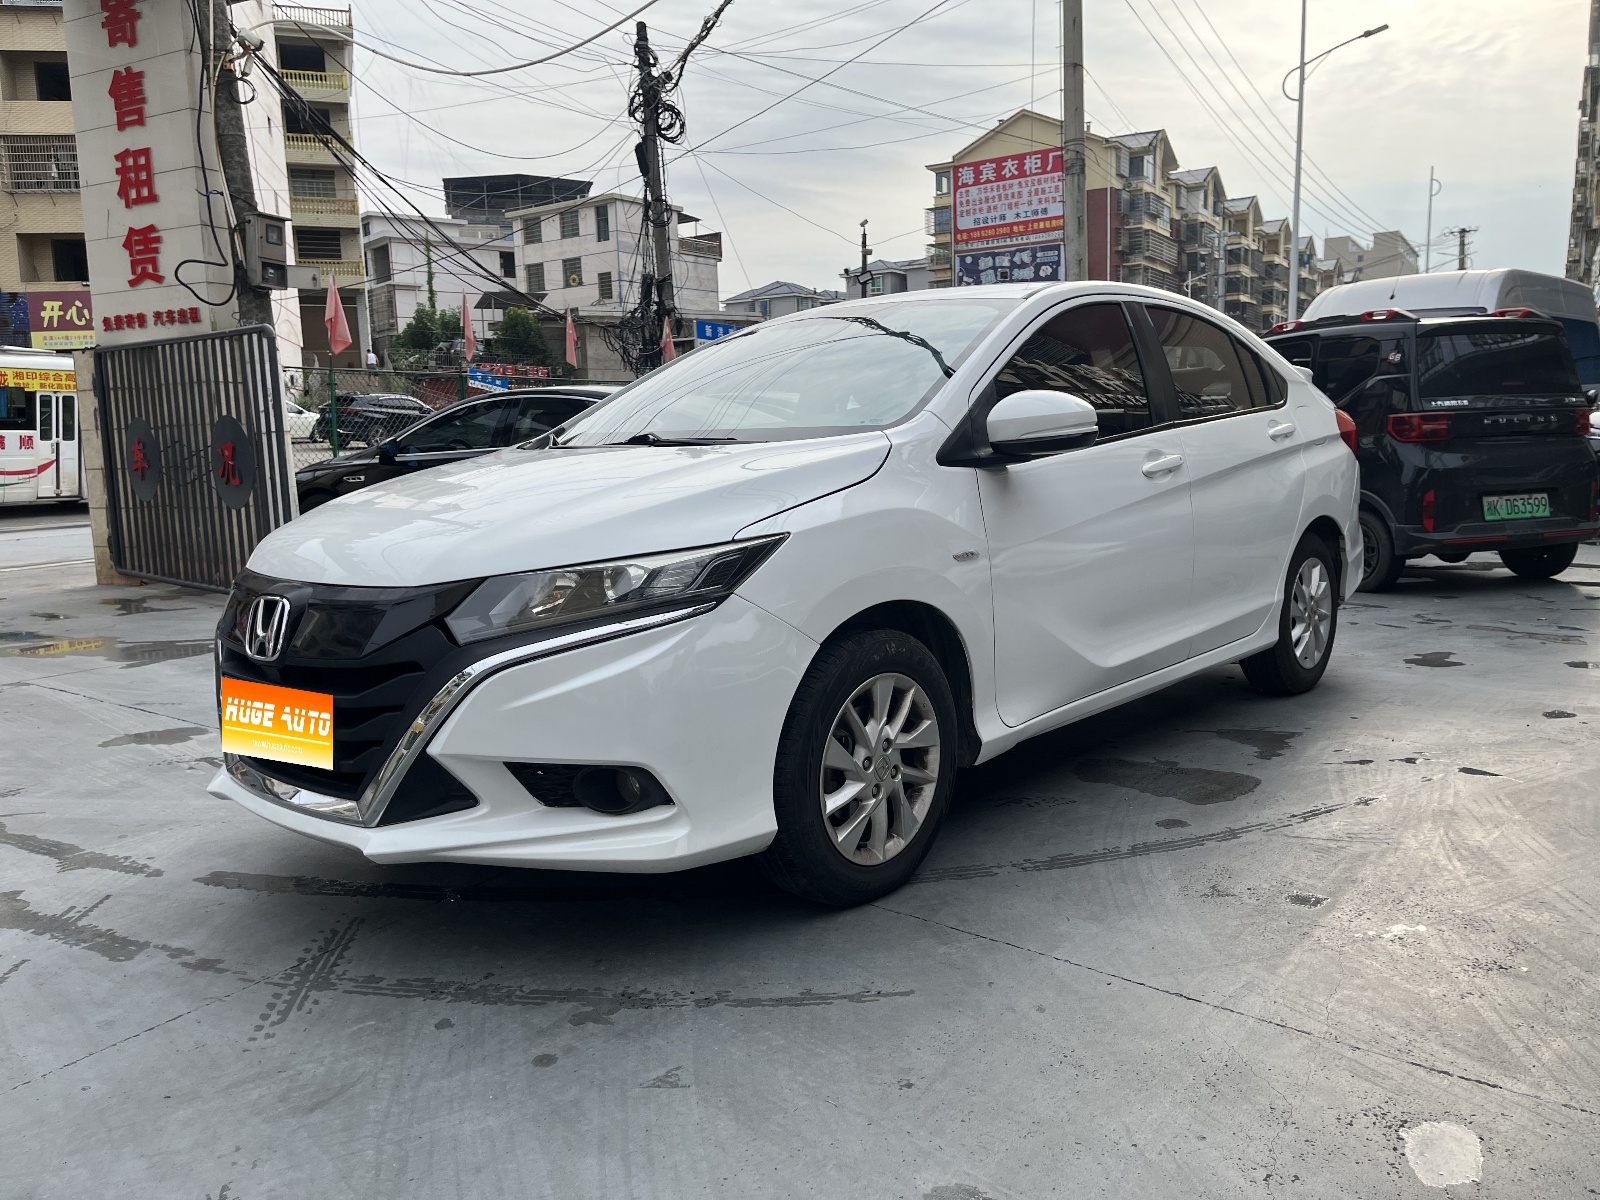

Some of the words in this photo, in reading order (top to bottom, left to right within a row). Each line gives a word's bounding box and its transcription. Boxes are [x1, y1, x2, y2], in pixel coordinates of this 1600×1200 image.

[100, 0, 166, 288] 寄售租赁
[958, 151, 1063, 186] 海宾衣柜厂
[973, 213, 1007, 226] 招设计师
[1014, 207, 1049, 220] 木工师傅
[153, 307, 202, 327] 汽车出租
[1505, 497, 1548, 515] D63599
